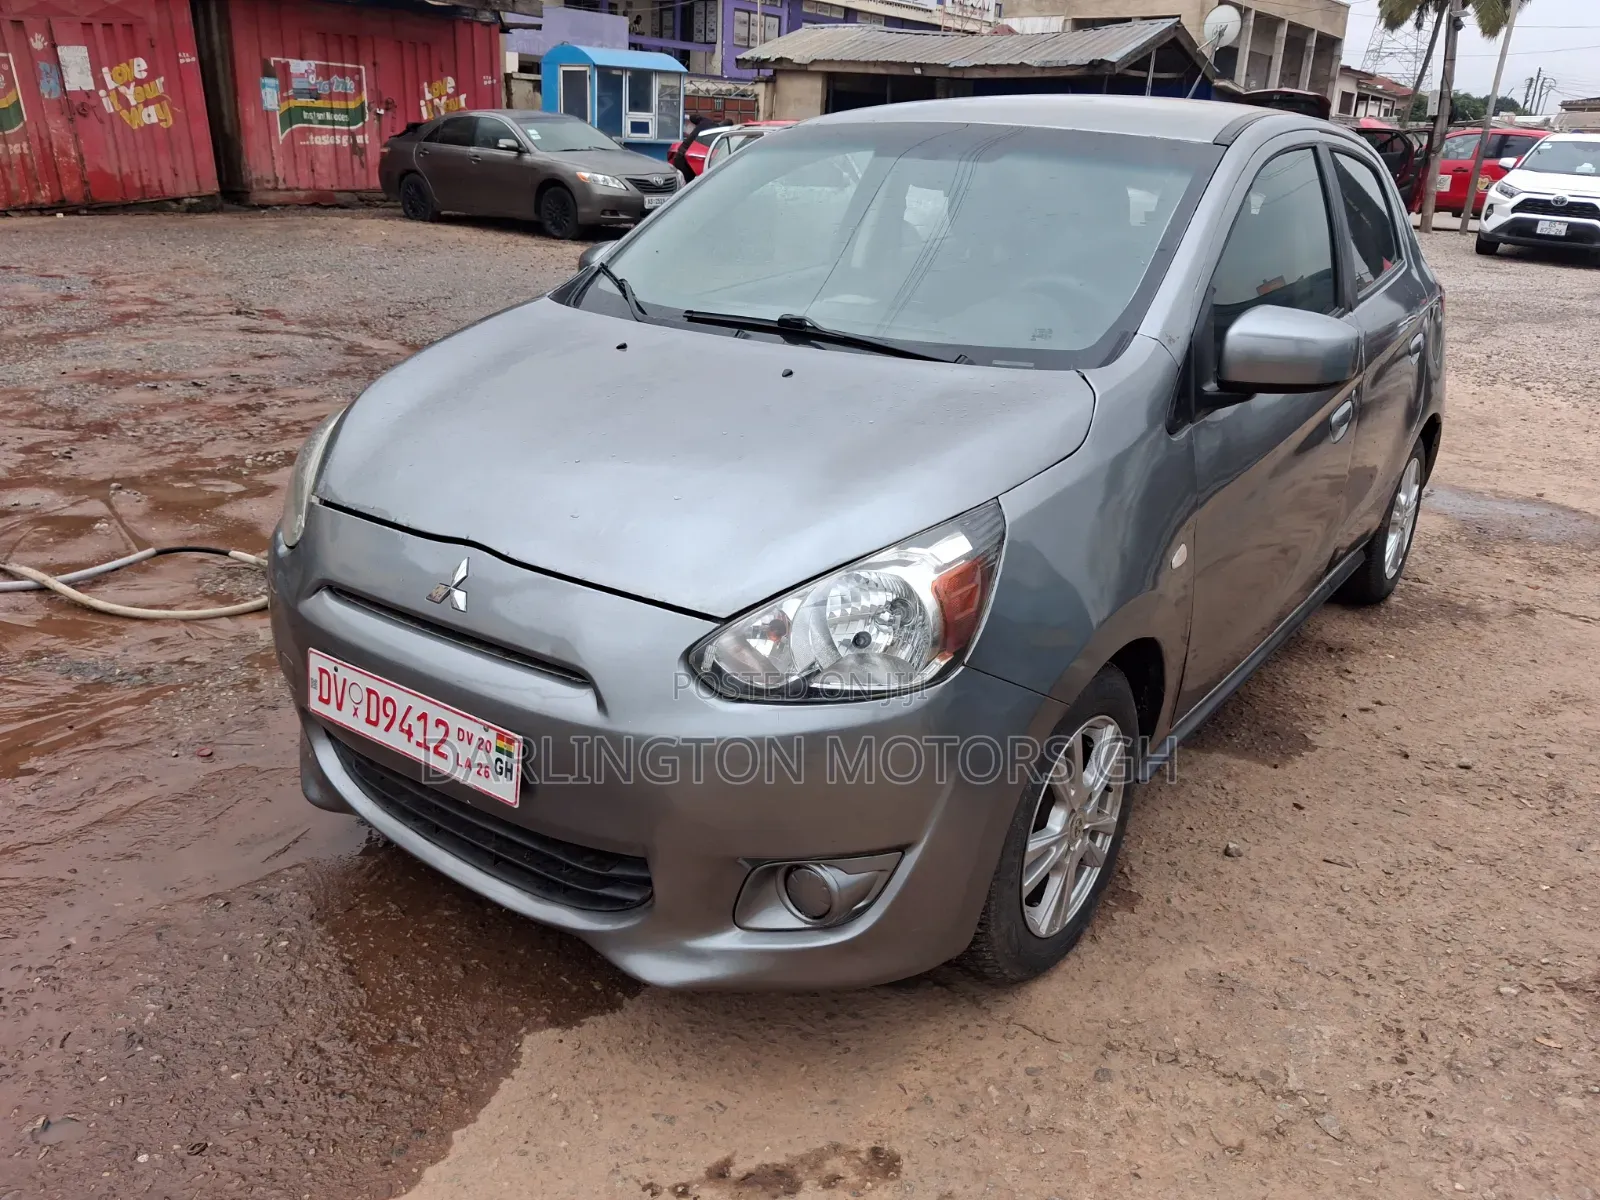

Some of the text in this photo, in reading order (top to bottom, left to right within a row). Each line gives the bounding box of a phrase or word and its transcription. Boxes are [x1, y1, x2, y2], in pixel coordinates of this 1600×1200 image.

[118, 76, 164, 106] Your
[318, 666, 347, 712] DV
[365, 687, 450, 760] D9412
[457, 727, 492, 753] DV 20
[456, 752, 490, 779] LA 26
[494, 757, 513, 781] GH
